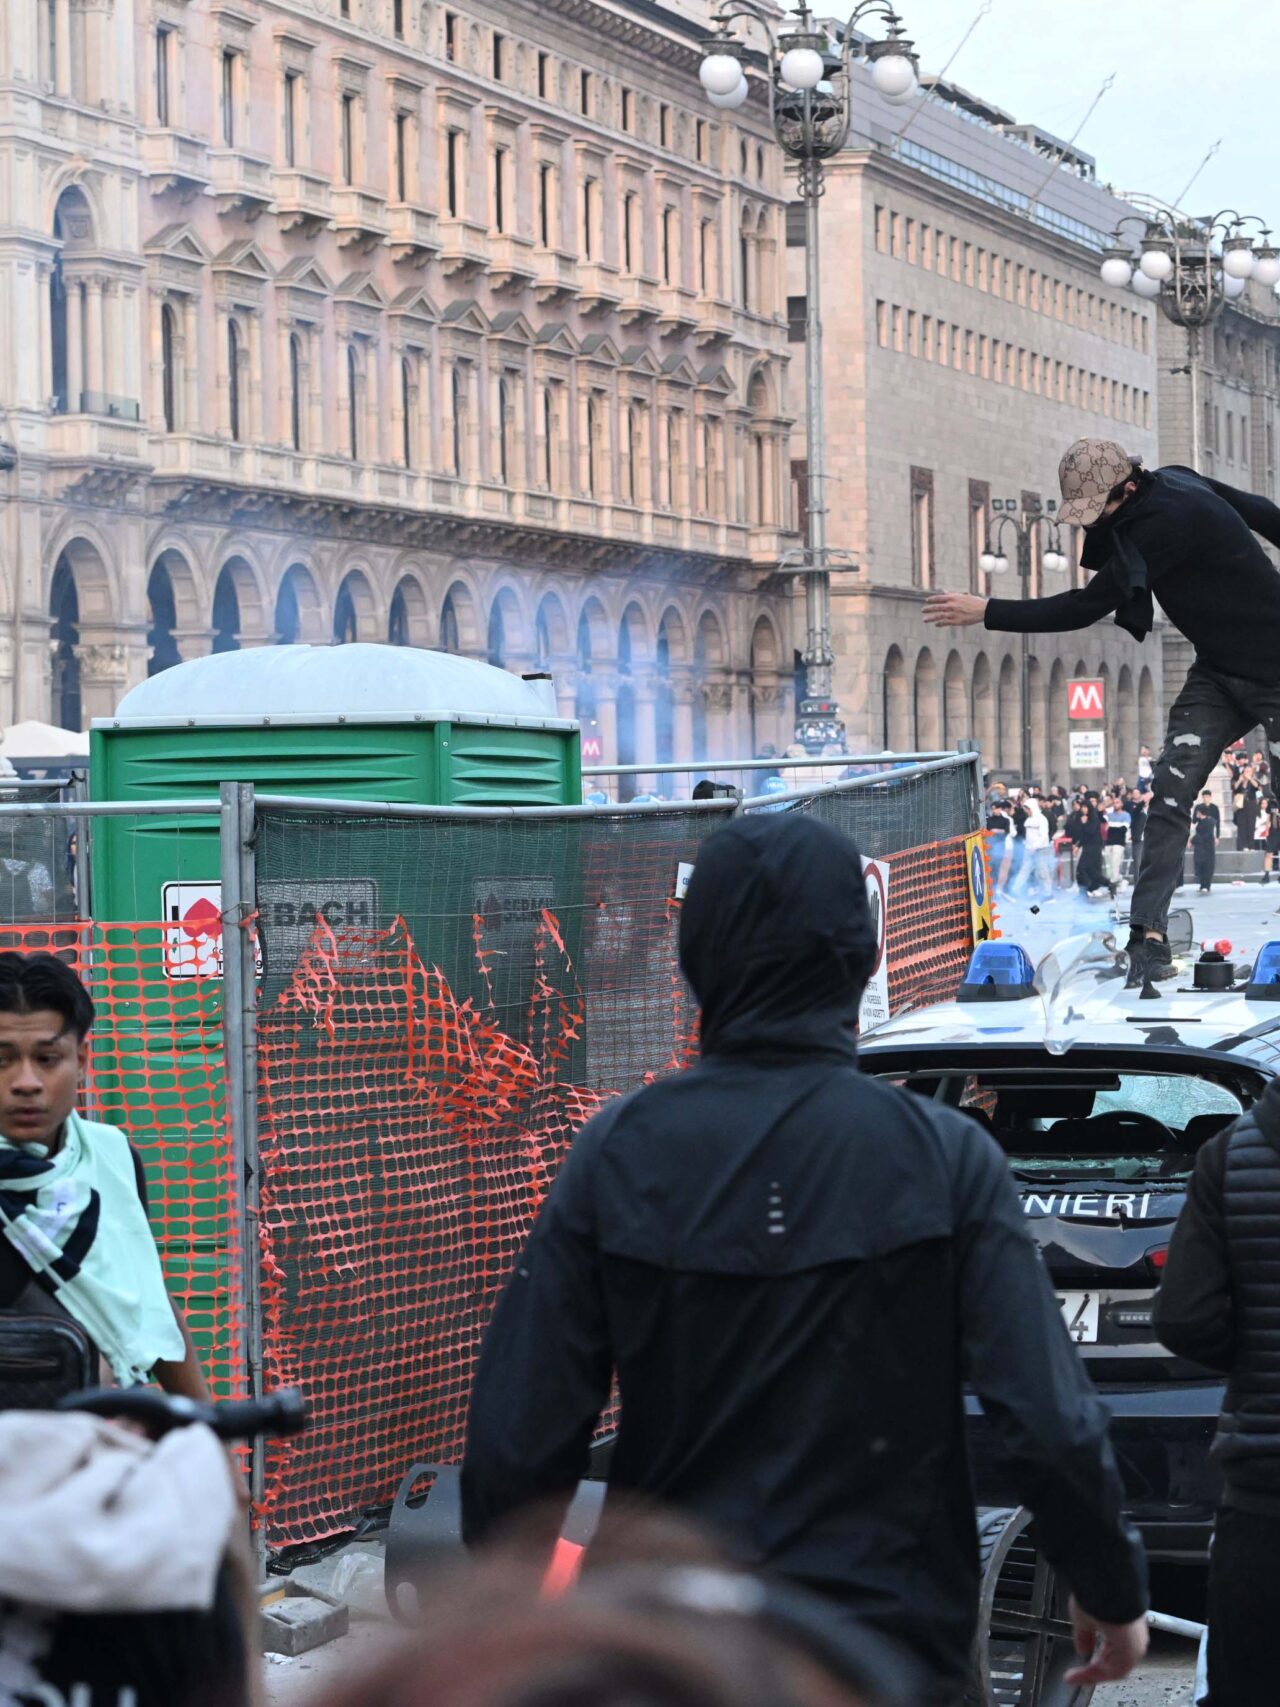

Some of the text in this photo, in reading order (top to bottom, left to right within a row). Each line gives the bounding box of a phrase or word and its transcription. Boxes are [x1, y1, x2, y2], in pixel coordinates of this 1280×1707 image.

[1070, 685, 1103, 710] M
[1019, 1194, 1150, 1218] NIERI
[1056, 1293, 1091, 1341] 4
